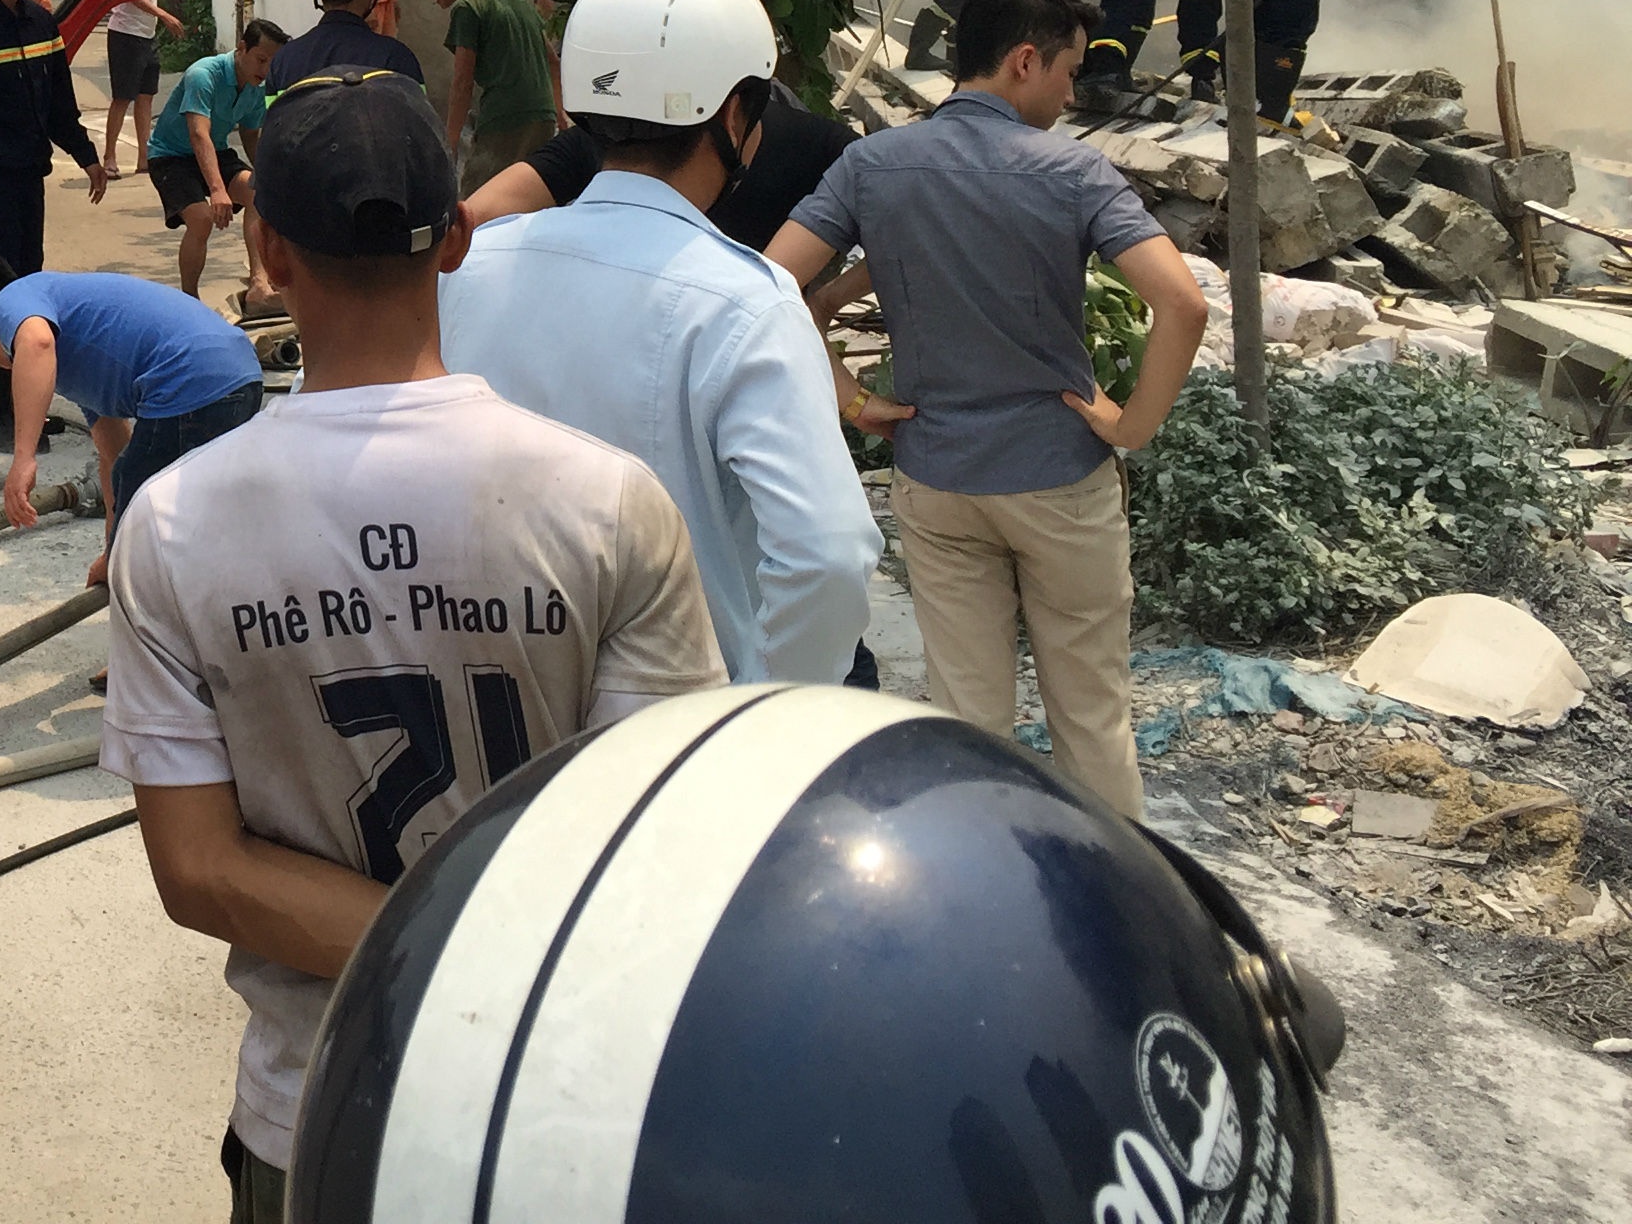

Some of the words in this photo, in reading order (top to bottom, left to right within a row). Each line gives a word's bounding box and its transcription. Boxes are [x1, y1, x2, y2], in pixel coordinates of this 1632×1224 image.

[592, 89, 622, 97] HONDA
[359, 522, 419, 572] CĐ
[231, 594, 310, 653] Phê
[318, 587, 373, 637] Rô
[407, 584, 508, 634] Phao
[523, 585, 568, 636] Lô
